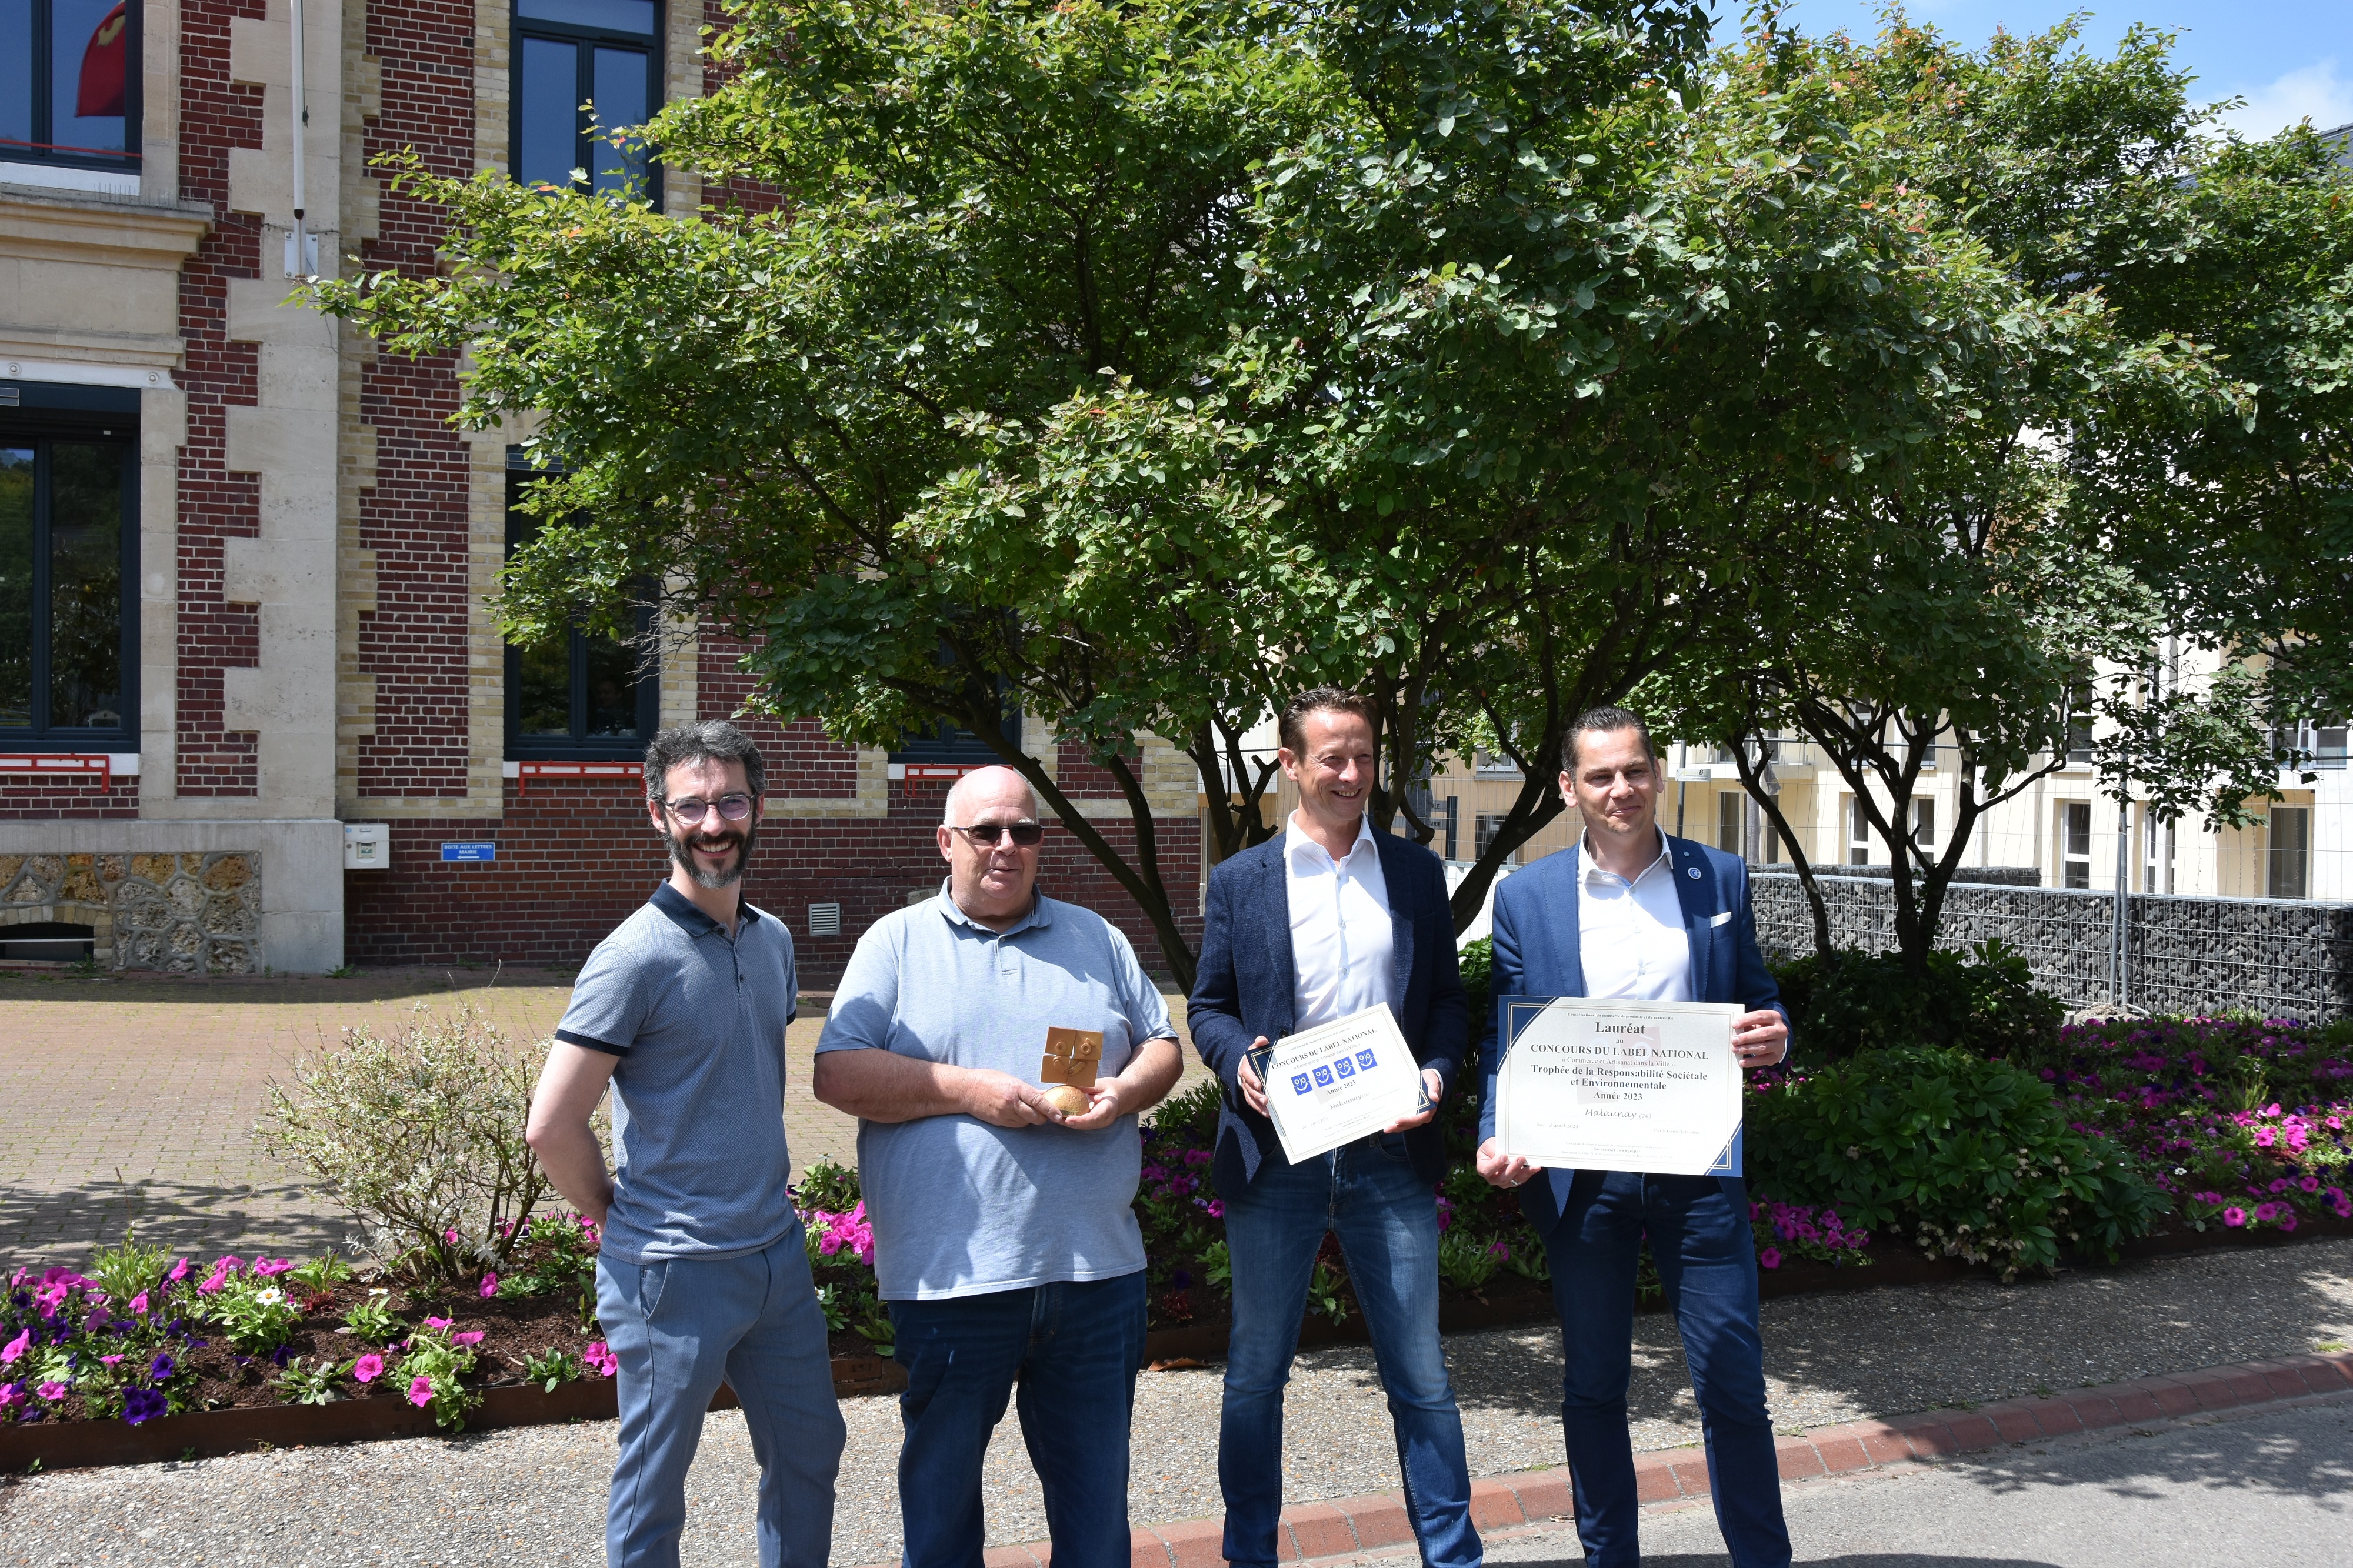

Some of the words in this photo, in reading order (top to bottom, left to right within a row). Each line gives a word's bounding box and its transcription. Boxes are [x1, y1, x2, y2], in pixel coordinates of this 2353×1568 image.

[1595, 1022, 1645, 1035] Lauréat
[1272, 1053, 1308, 1070] CONCOURS
[1309, 1049, 1319, 1057] DU
[1319, 1042, 1342, 1053] LABEL
[1342, 1028, 1377, 1045] NATIONAL
[1531, 1044, 1592, 1055] CONCOURS
[1595, 1046, 1610, 1055] DU
[1613, 1047, 1649, 1057] LABEL
[1651, 1049, 1709, 1059] NATIONAL
[1531, 1065, 1569, 1075] Trophée
[1597, 1067, 1664, 1078] Responsabilité
[1667, 1070, 1708, 1080] Sociétale
[1327, 1085, 1343, 1096] Année
[1344, 1080, 1357, 1089] 2023
[1582, 1078, 1667, 1090] Environnementale
[1330, 1095, 1361, 1110] Malaunay
[1623, 1092, 1642, 1100] 2023
[1585, 1107, 1637, 1120] Malaunay
